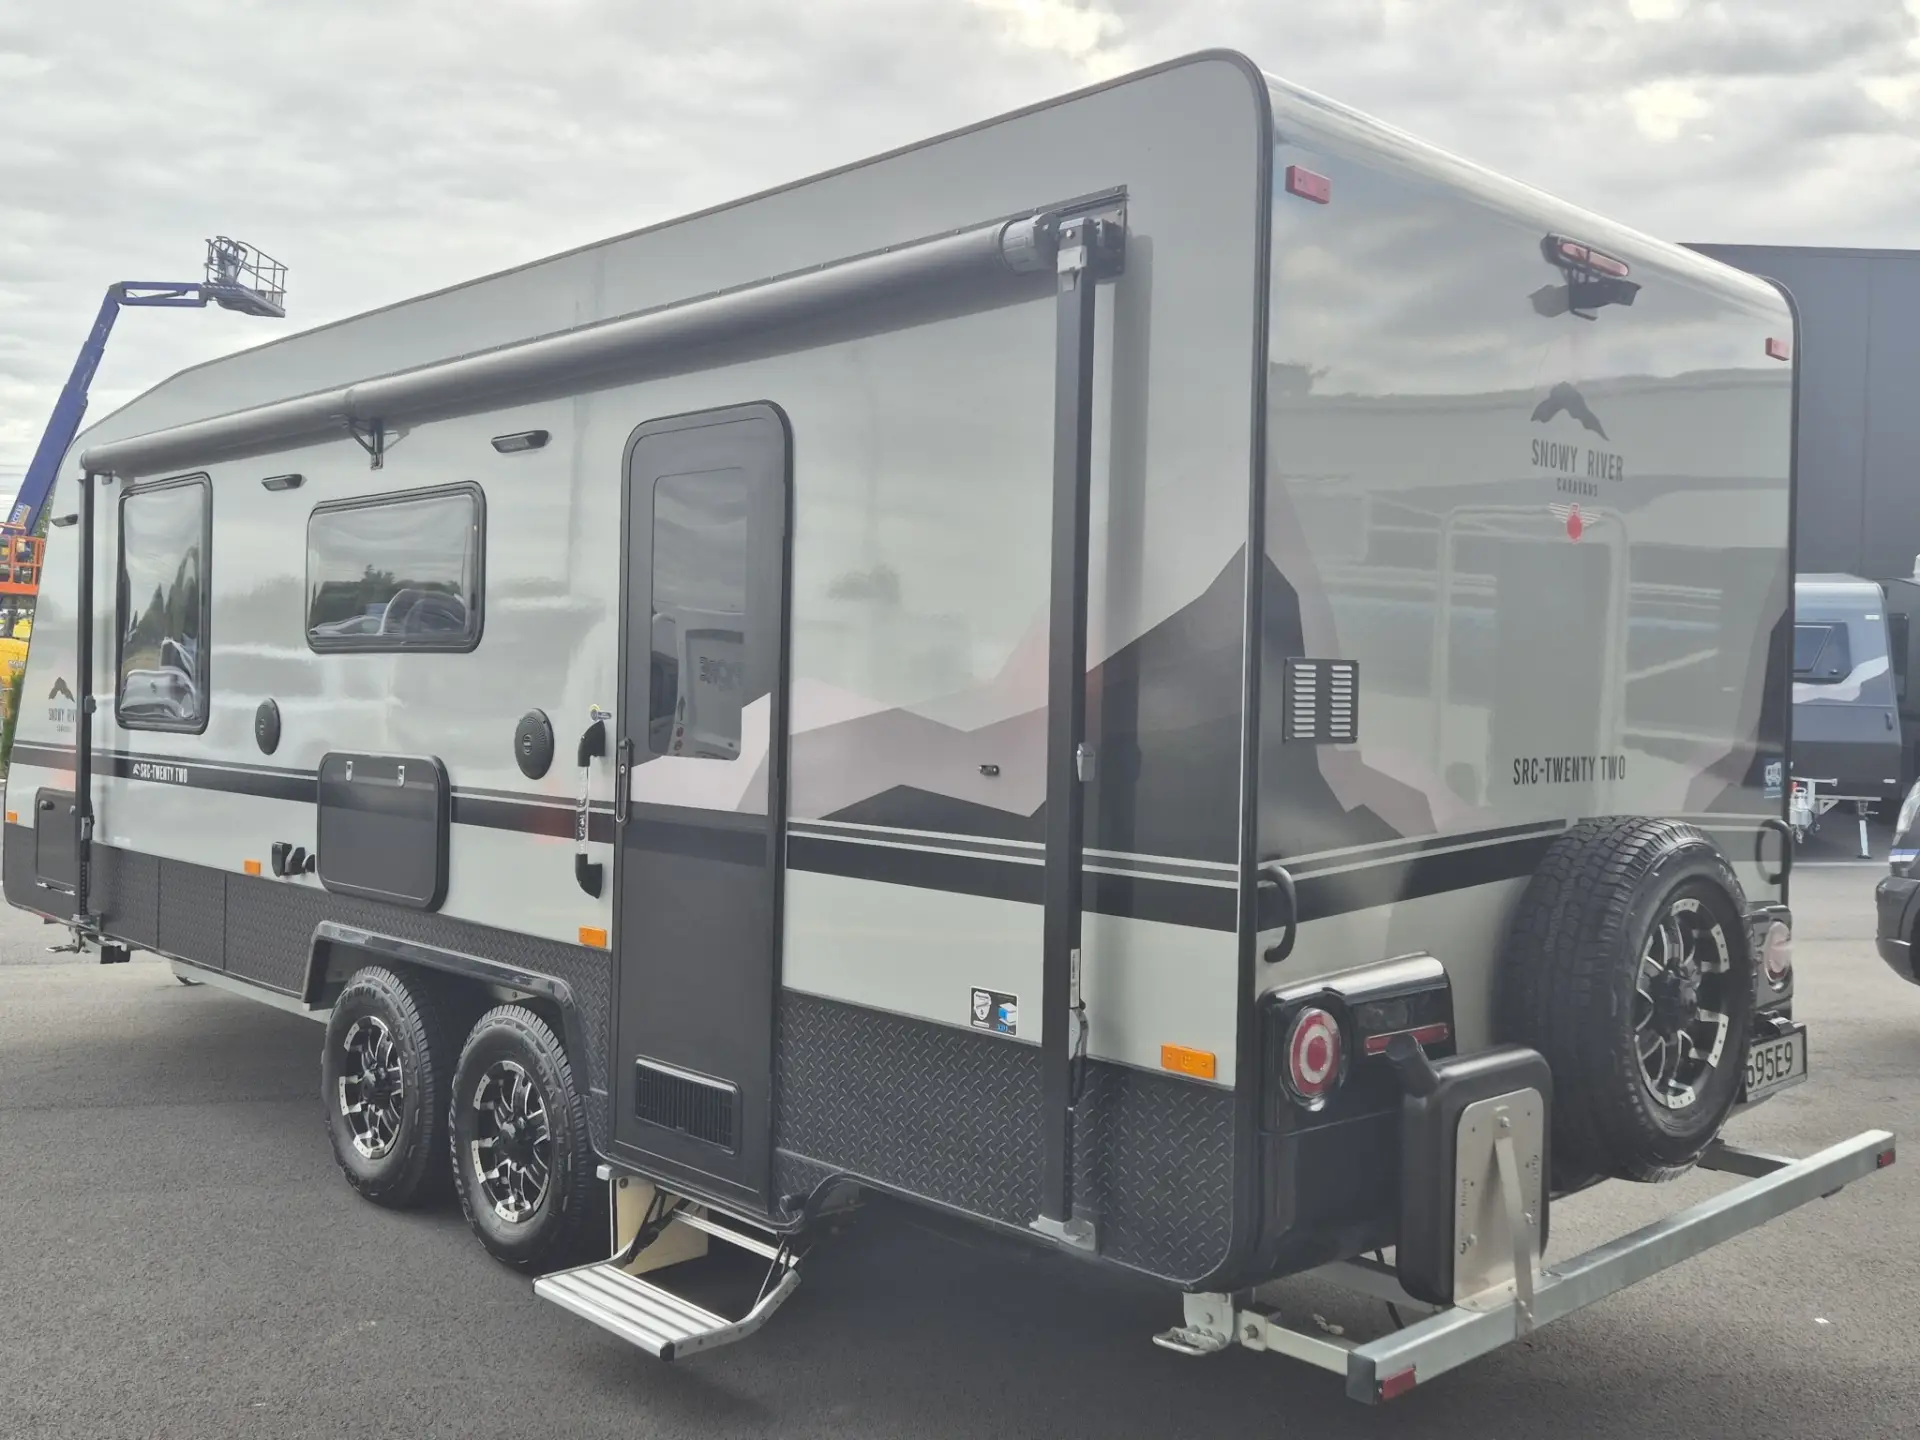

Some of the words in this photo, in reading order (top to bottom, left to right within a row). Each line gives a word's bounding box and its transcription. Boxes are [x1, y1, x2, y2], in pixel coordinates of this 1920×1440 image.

[1531, 438, 1578, 473] SNOWY
[1587, 449, 1624, 482] RIVER
[1556, 477, 1598, 497] CARAVANS
[175, 767, 188, 783] TWO
[1513, 756, 1596, 786] SRC-TWENTY
[1600, 754, 1626, 781] TWO
